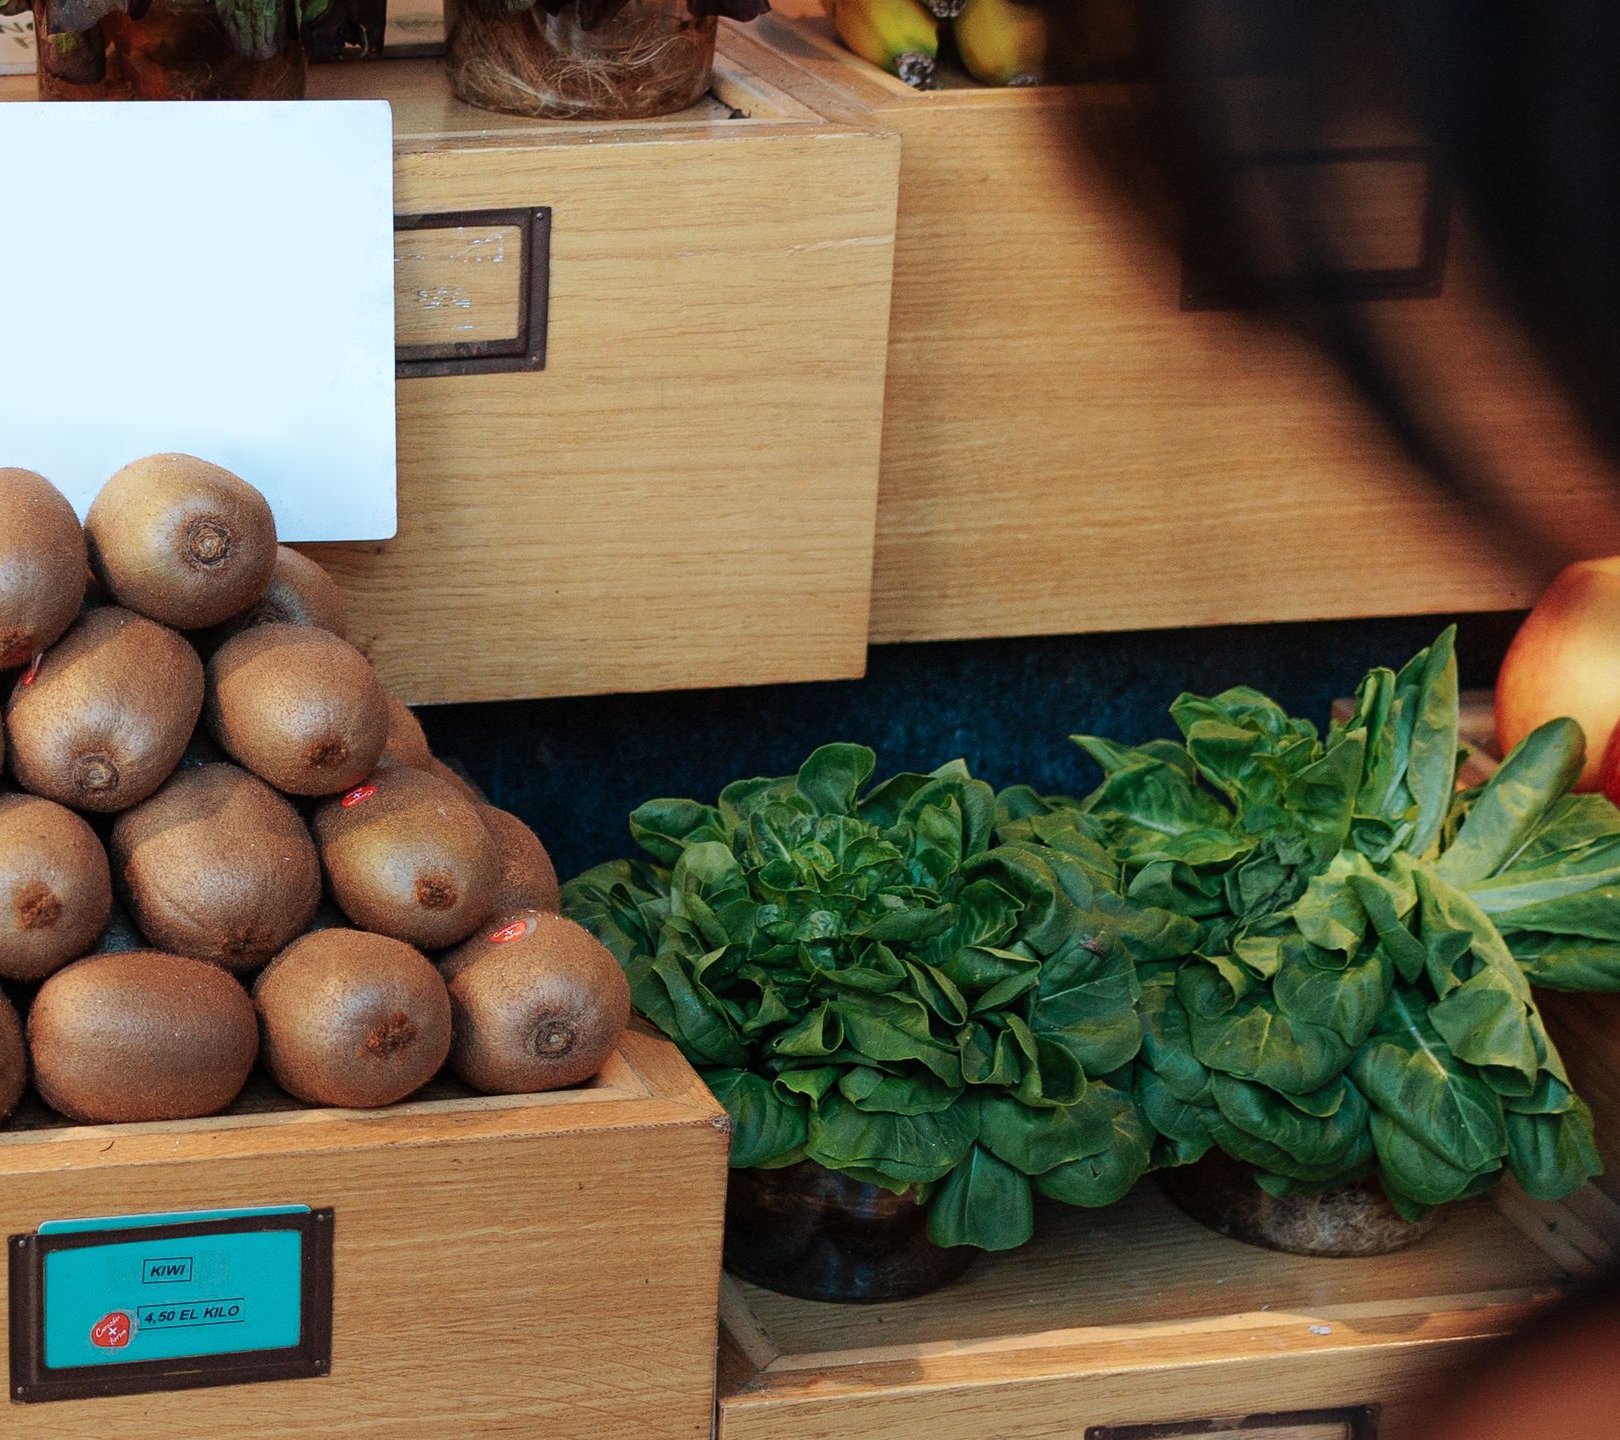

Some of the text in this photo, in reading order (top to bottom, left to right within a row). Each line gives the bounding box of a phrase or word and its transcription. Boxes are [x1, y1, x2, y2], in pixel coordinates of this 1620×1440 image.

[150, 1264, 186, 1277] KIWI
[144, 1305, 240, 1325] 4,50 EL KILO
